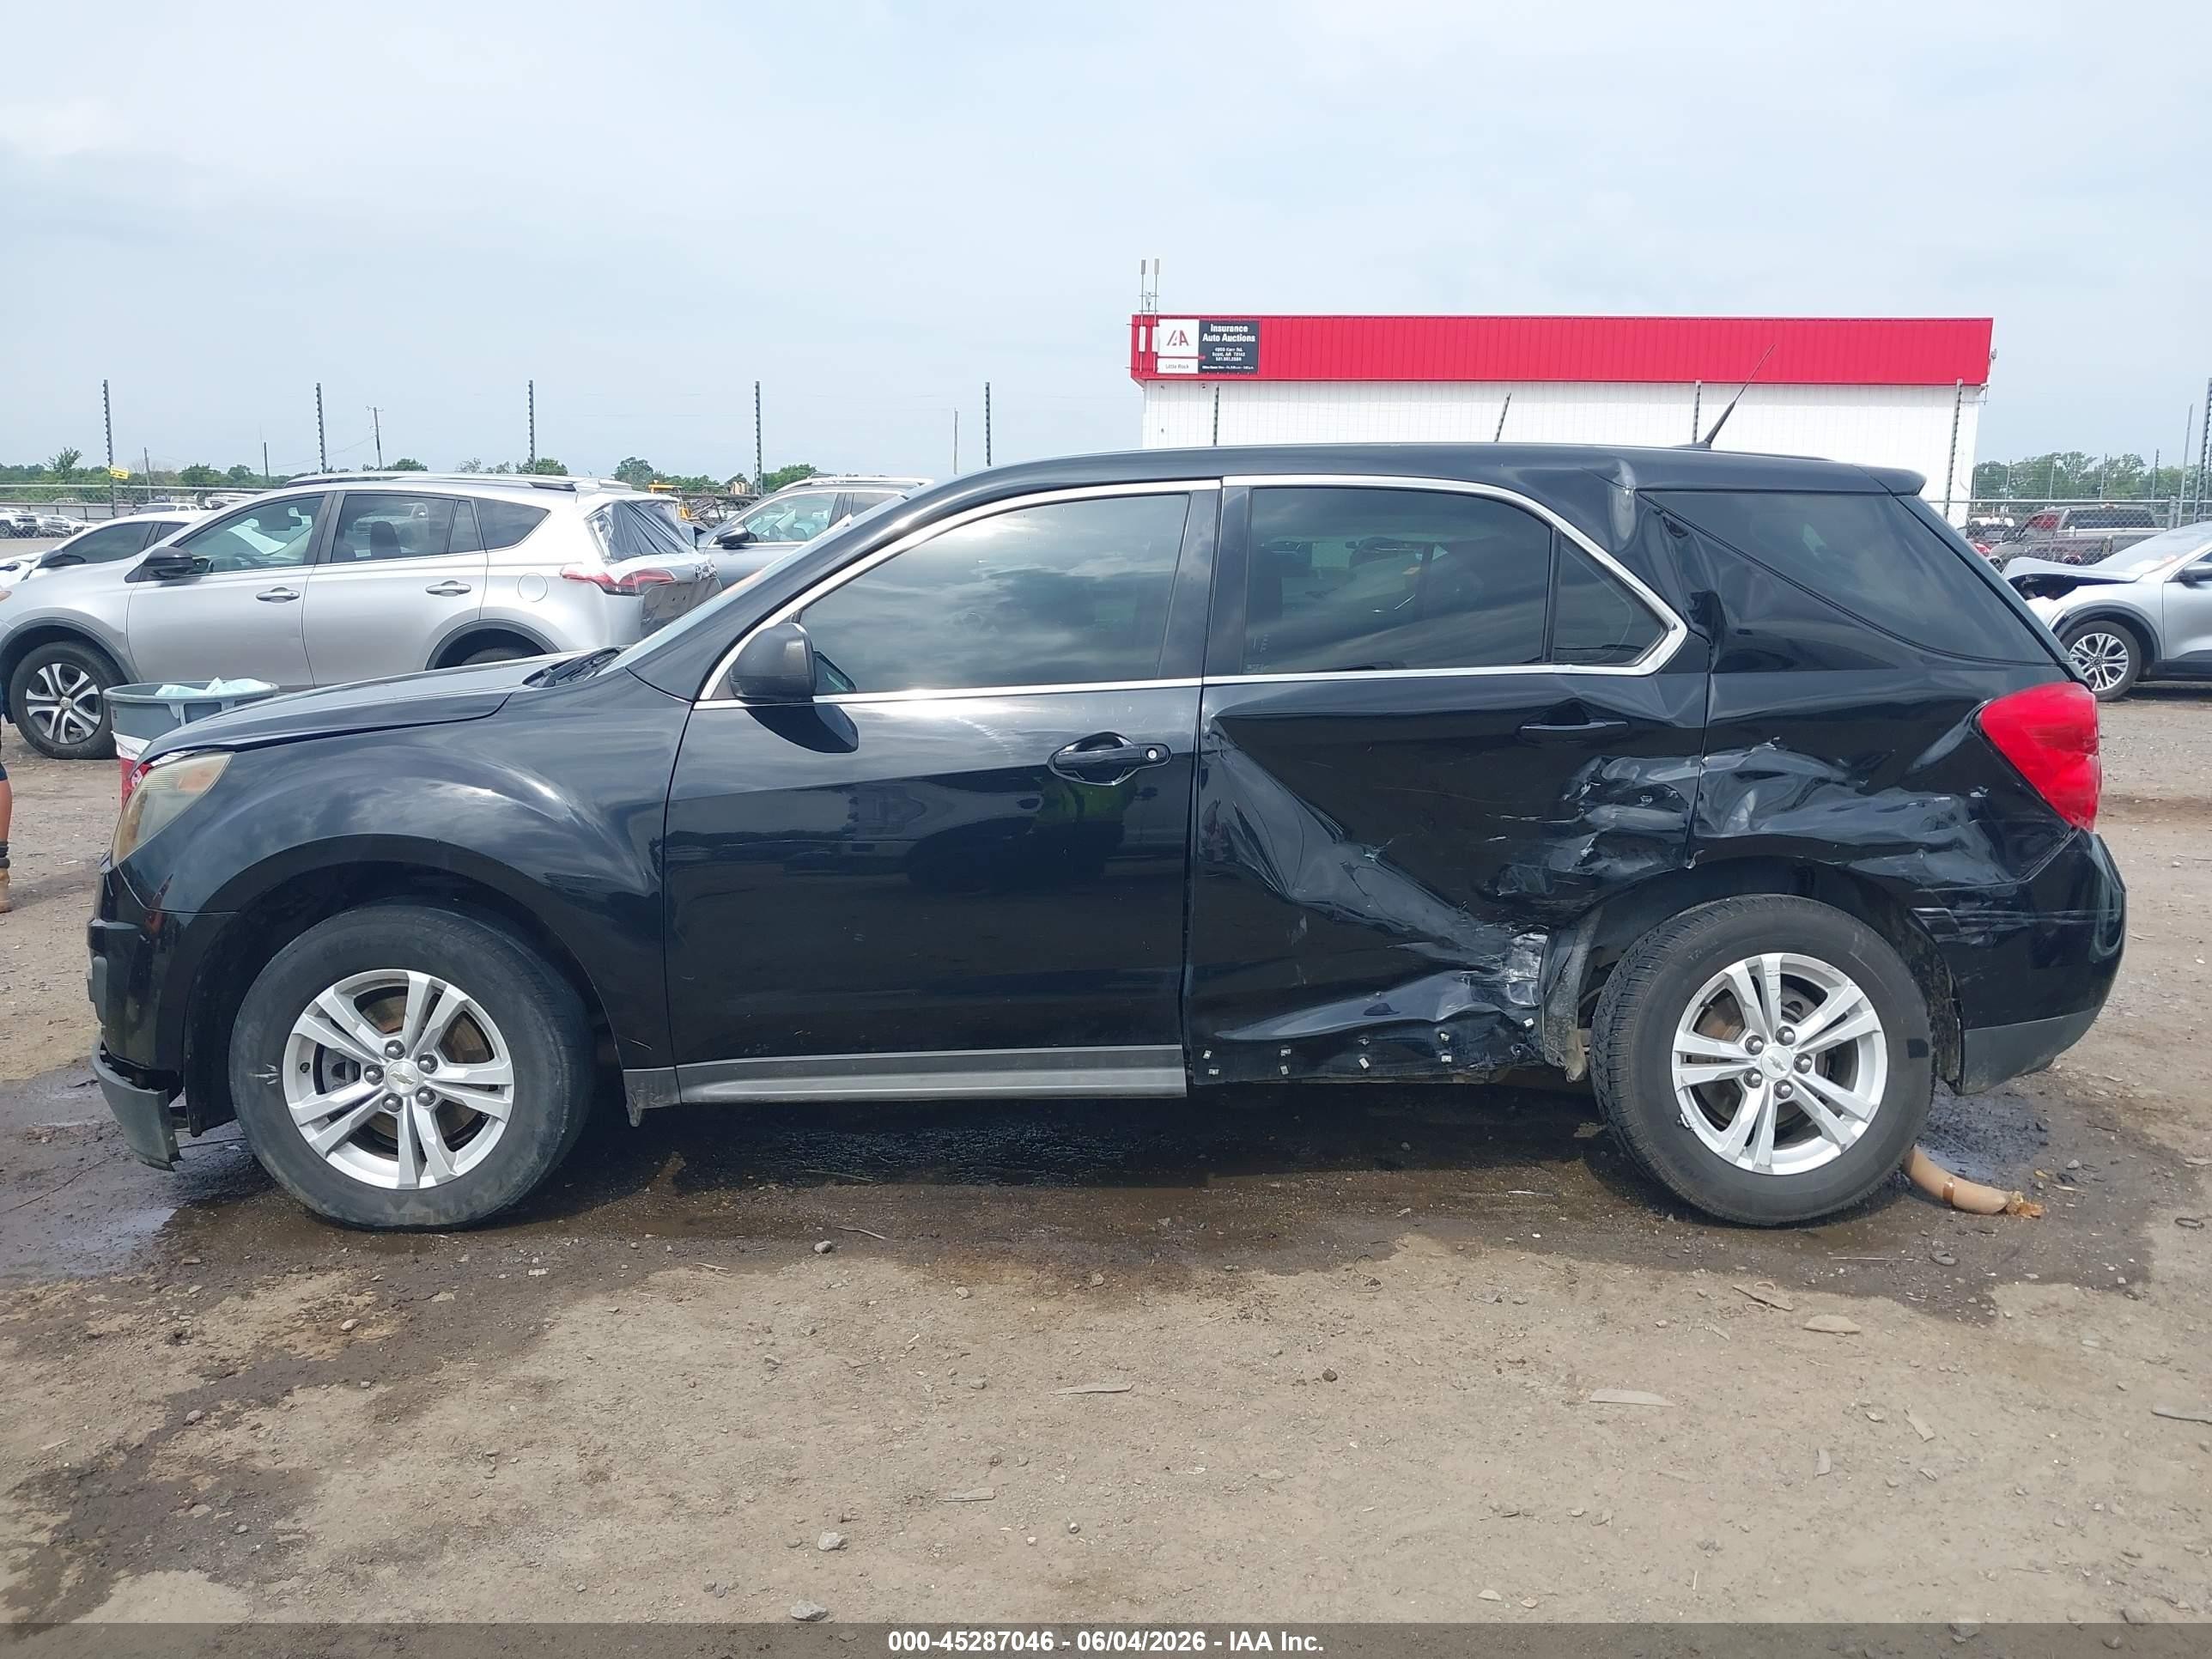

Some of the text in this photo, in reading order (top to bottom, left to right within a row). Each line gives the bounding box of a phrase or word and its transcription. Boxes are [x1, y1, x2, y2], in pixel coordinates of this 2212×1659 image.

[1210, 324, 1249, 332] Insurance
[1202, 333, 1255, 342] Auto Auctions
